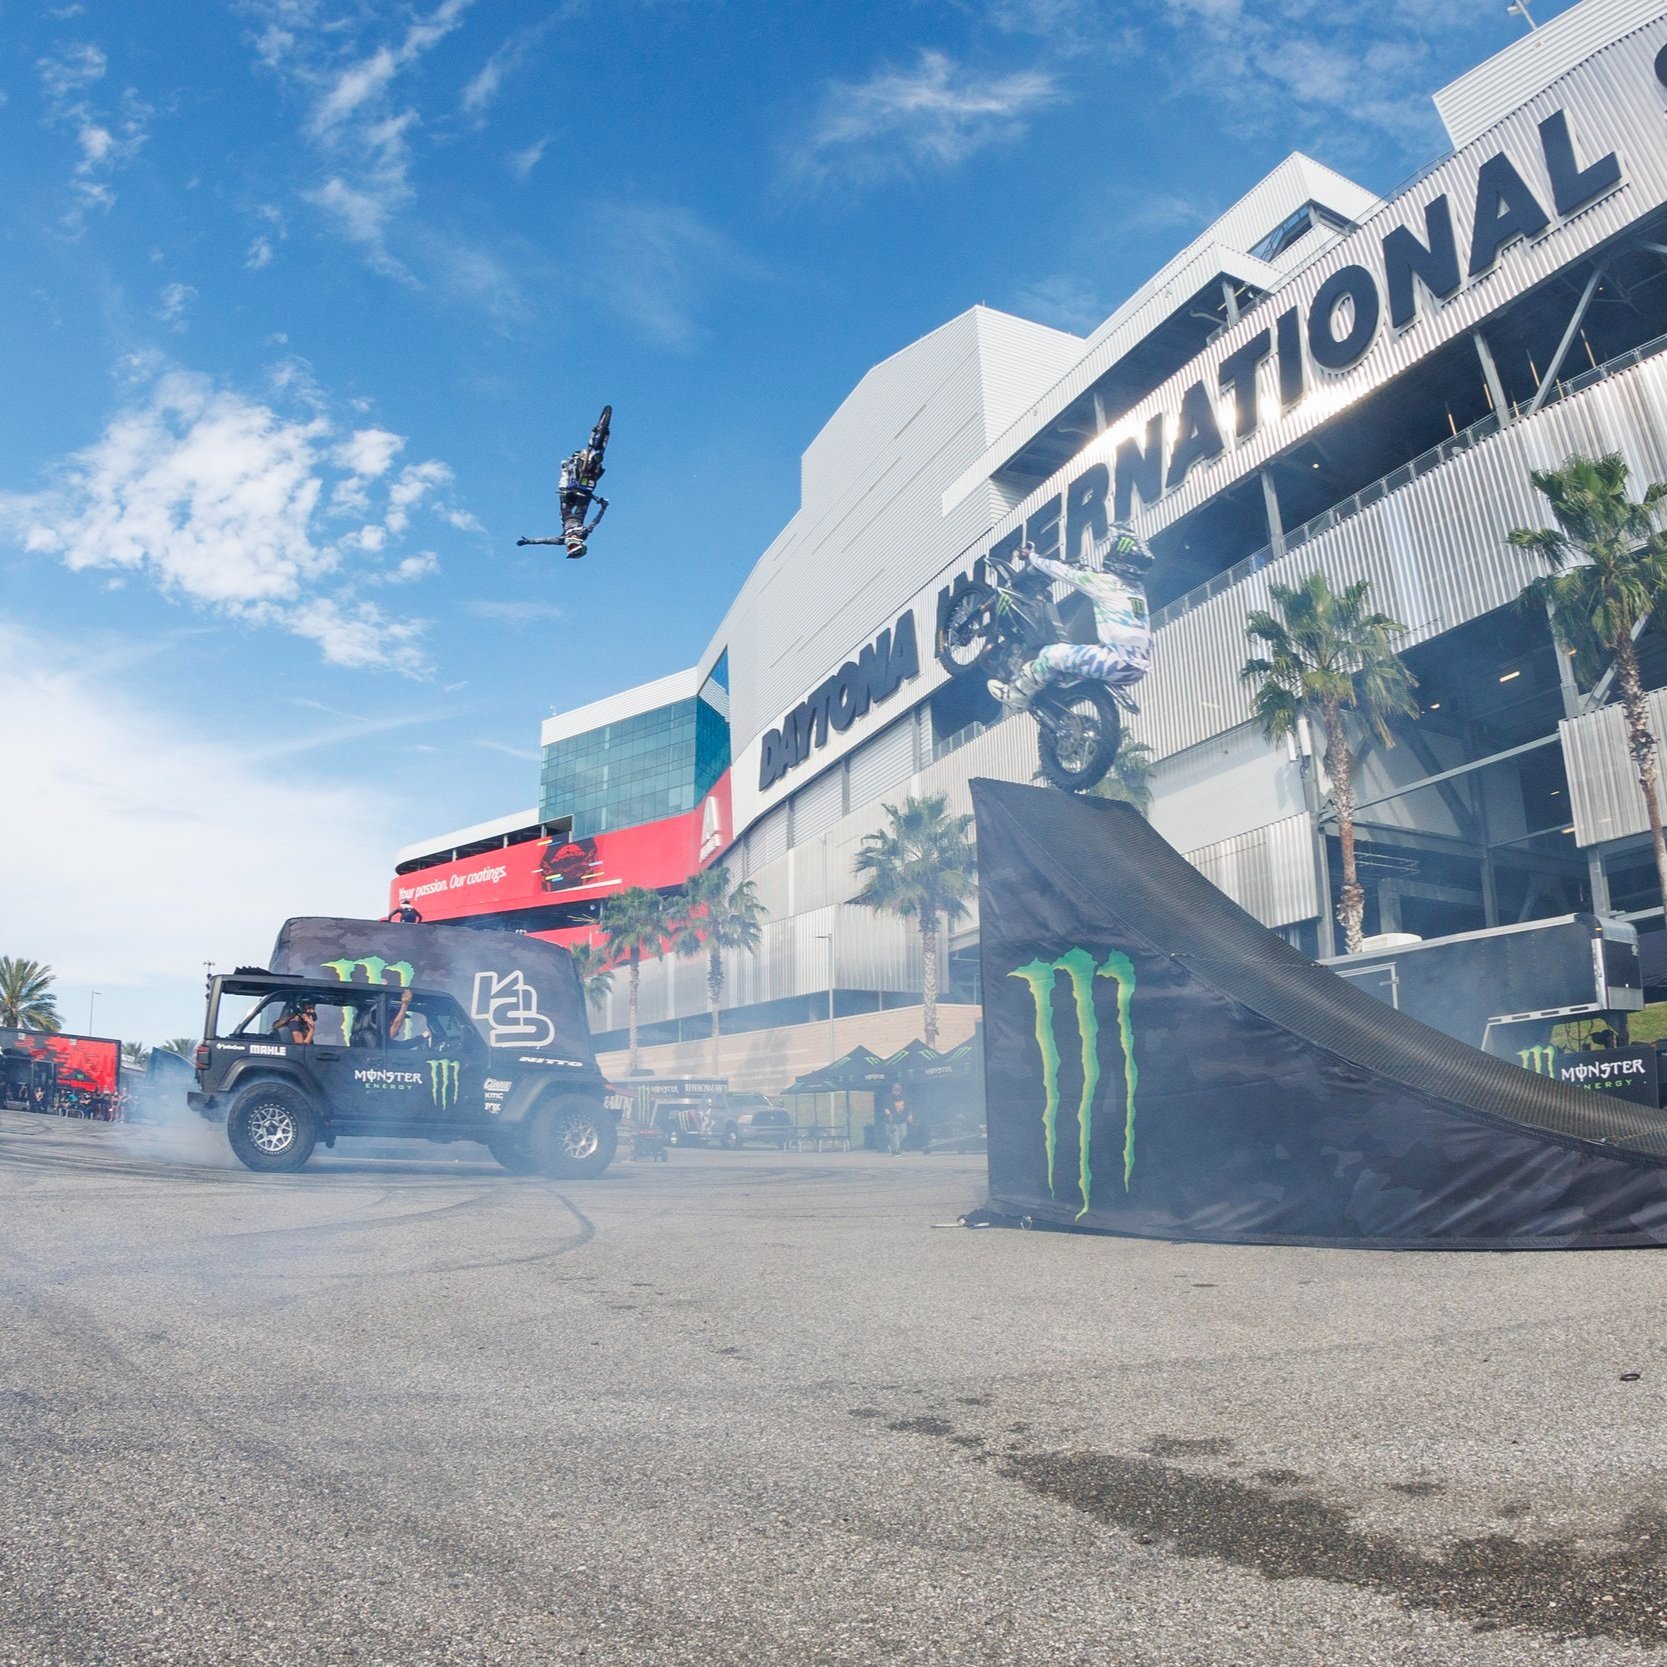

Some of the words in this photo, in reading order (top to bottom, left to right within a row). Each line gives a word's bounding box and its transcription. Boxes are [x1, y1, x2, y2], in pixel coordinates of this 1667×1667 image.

[759, 609, 920, 791] DAYTONA
[399, 887, 415, 900] Your
[415, 879, 448, 900] passion.
[450, 874, 466, 888] Our
[250, 1045, 286, 1056] MAHLE
[519, 1056, 584, 1067] NITTO
[1561, 1059, 1646, 1082] MONSTER
[354, 1069, 423, 1085] MONSTER
